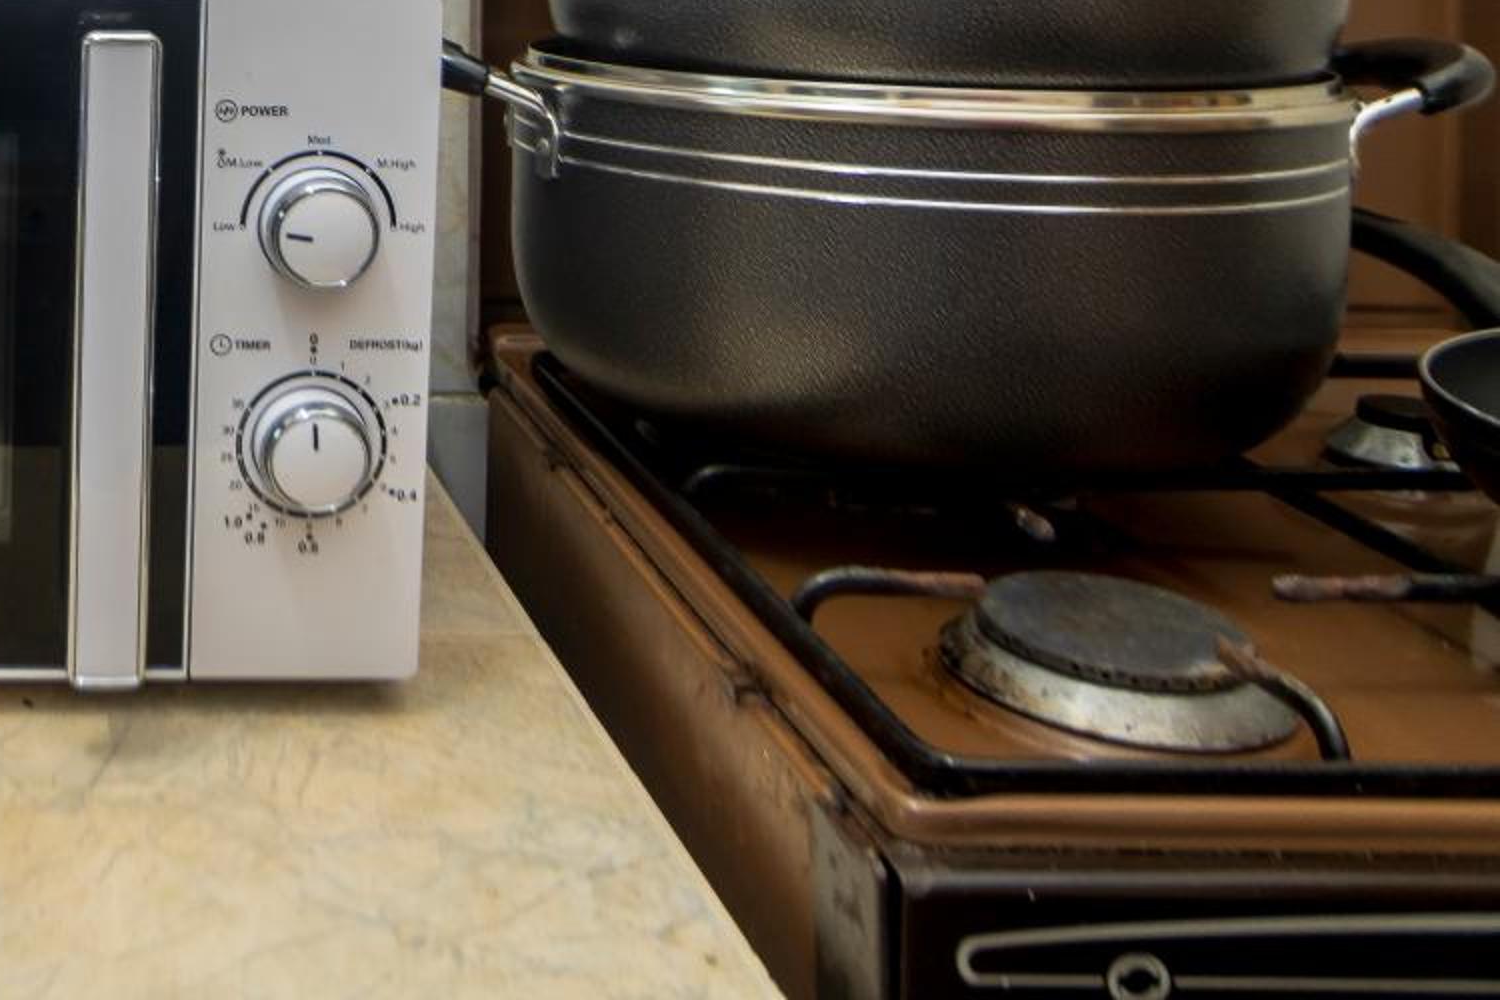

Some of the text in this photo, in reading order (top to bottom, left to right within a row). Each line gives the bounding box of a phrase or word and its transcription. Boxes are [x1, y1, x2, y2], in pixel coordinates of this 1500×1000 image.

[241, 105, 289, 117] POWER
[213, 222, 236, 232] Low
[235, 339, 272, 351] TIMER
